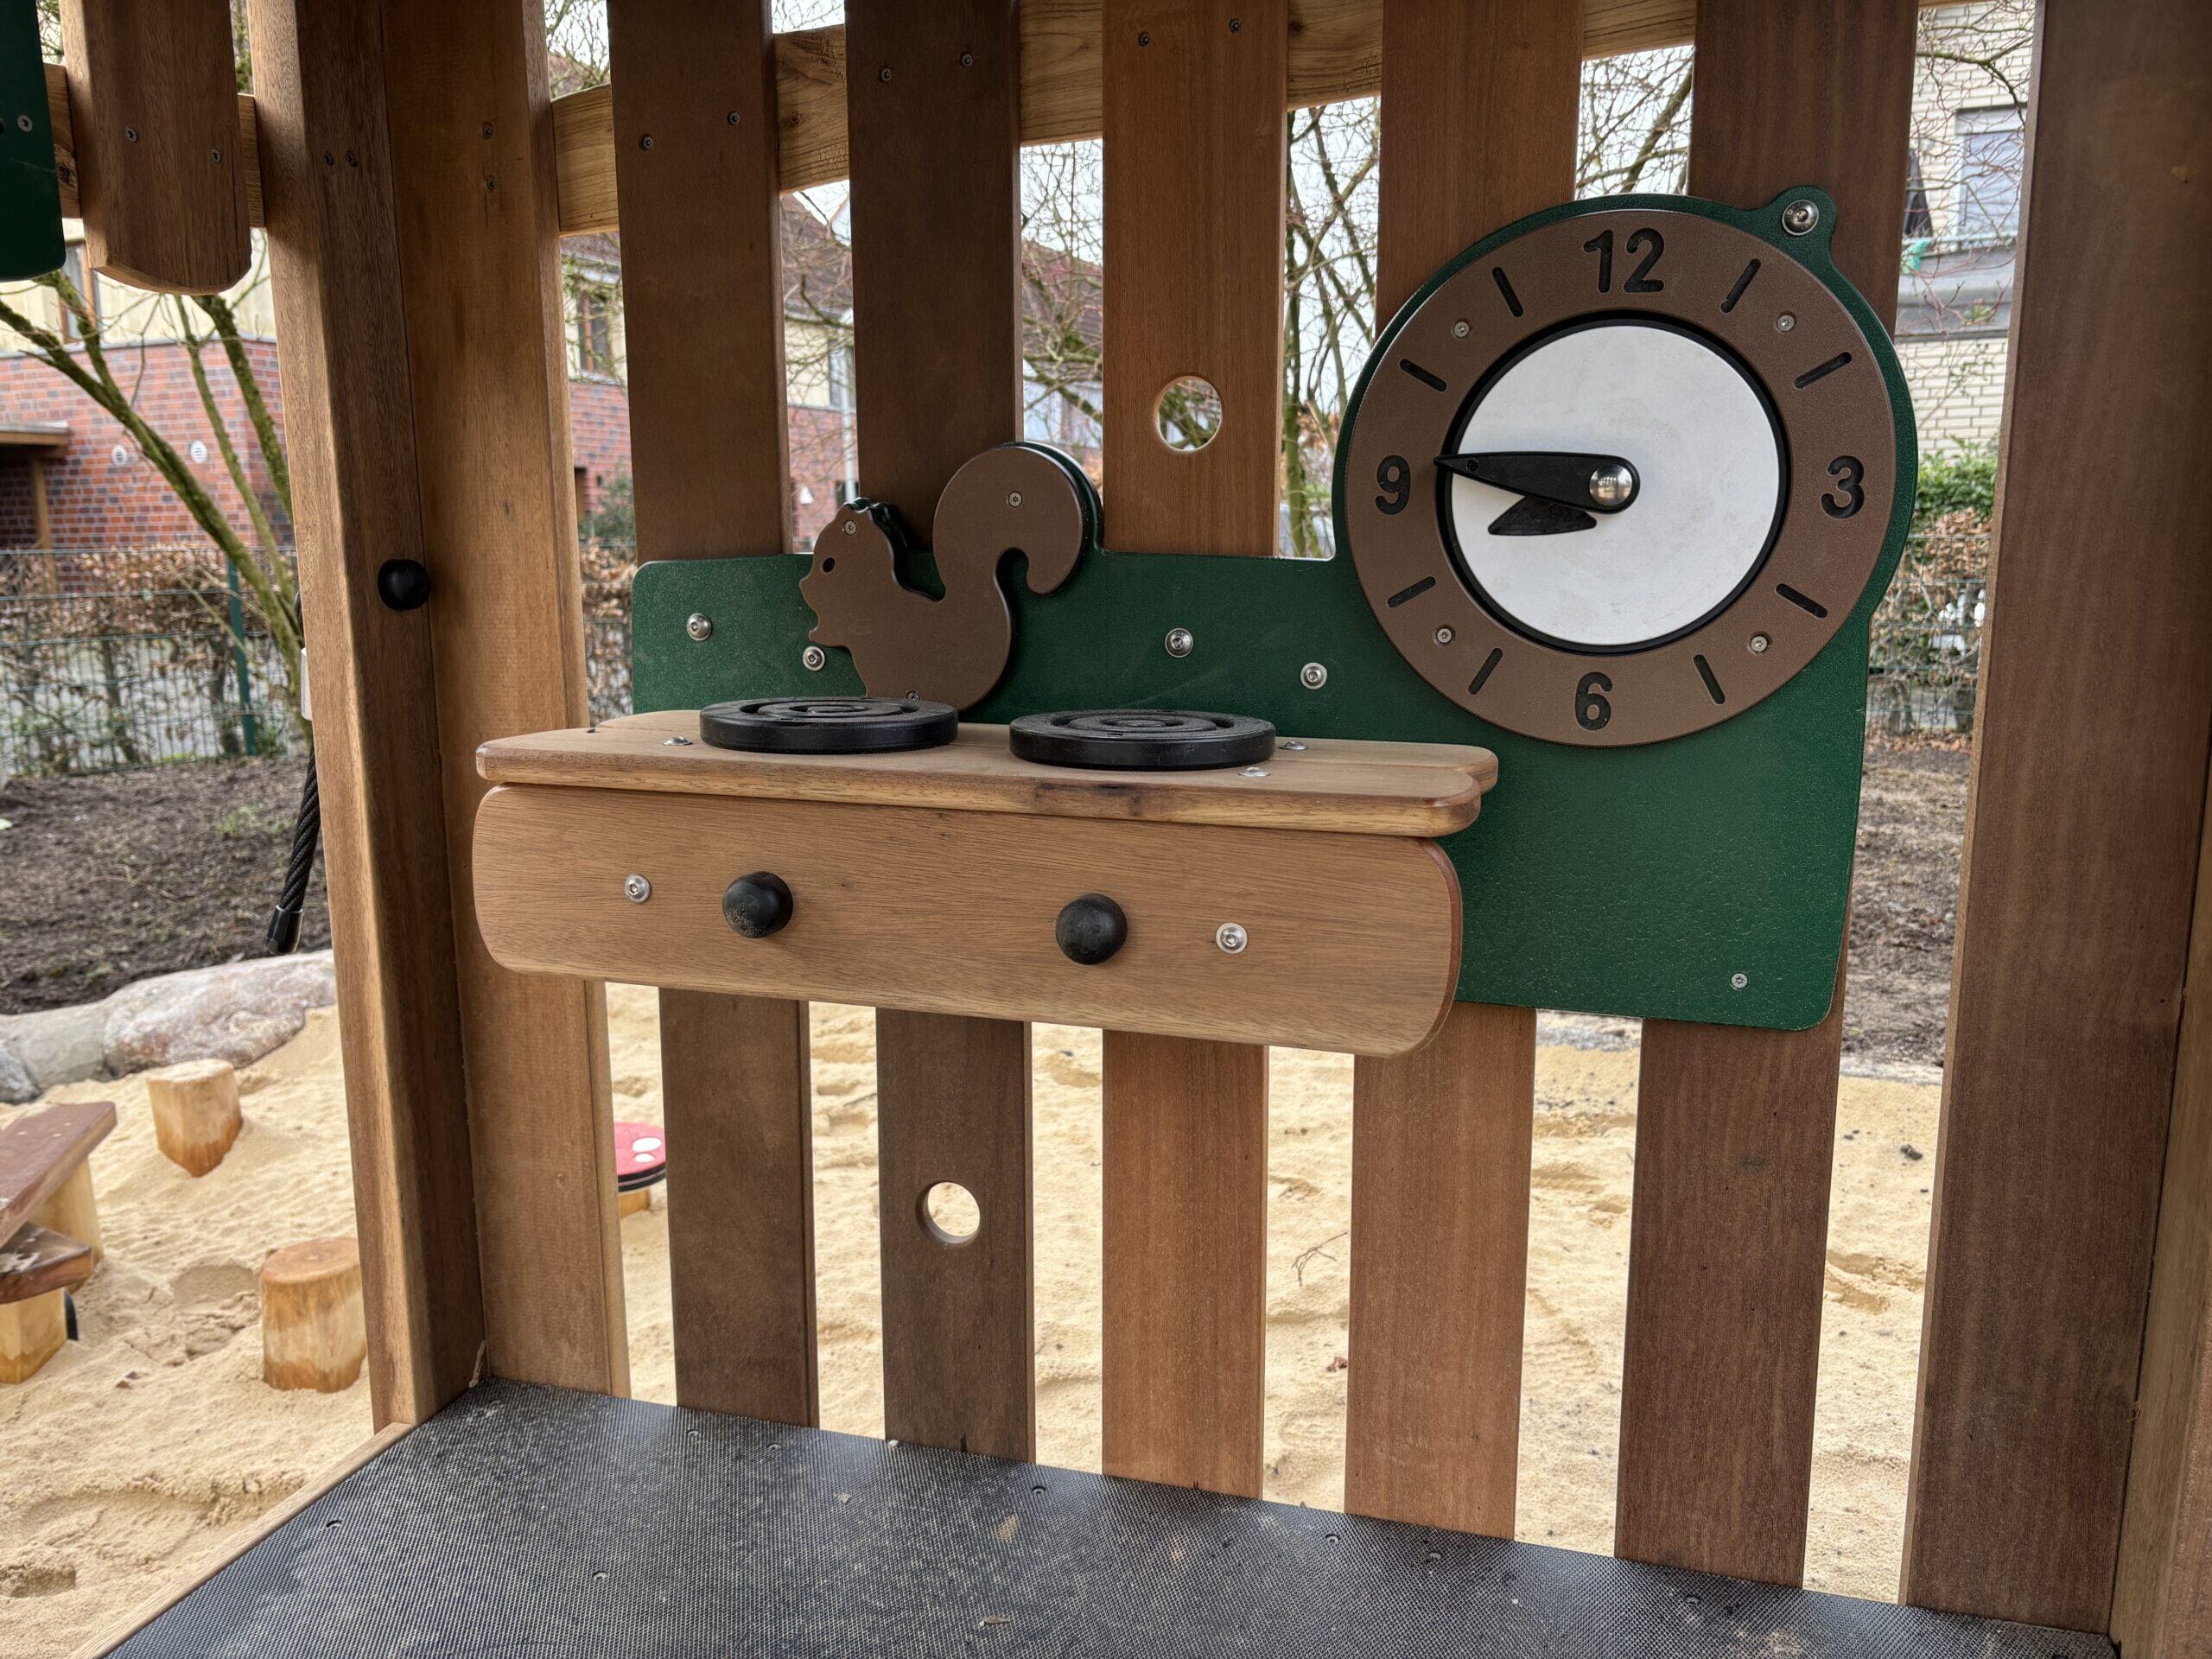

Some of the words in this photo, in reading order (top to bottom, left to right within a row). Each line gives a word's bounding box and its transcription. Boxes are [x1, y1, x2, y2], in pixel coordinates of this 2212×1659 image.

[1583, 227, 1664, 293] 12
[1375, 454, 1411, 515] 9
[1821, 454, 1865, 519] 3
[1574, 671, 1613, 731] 6
